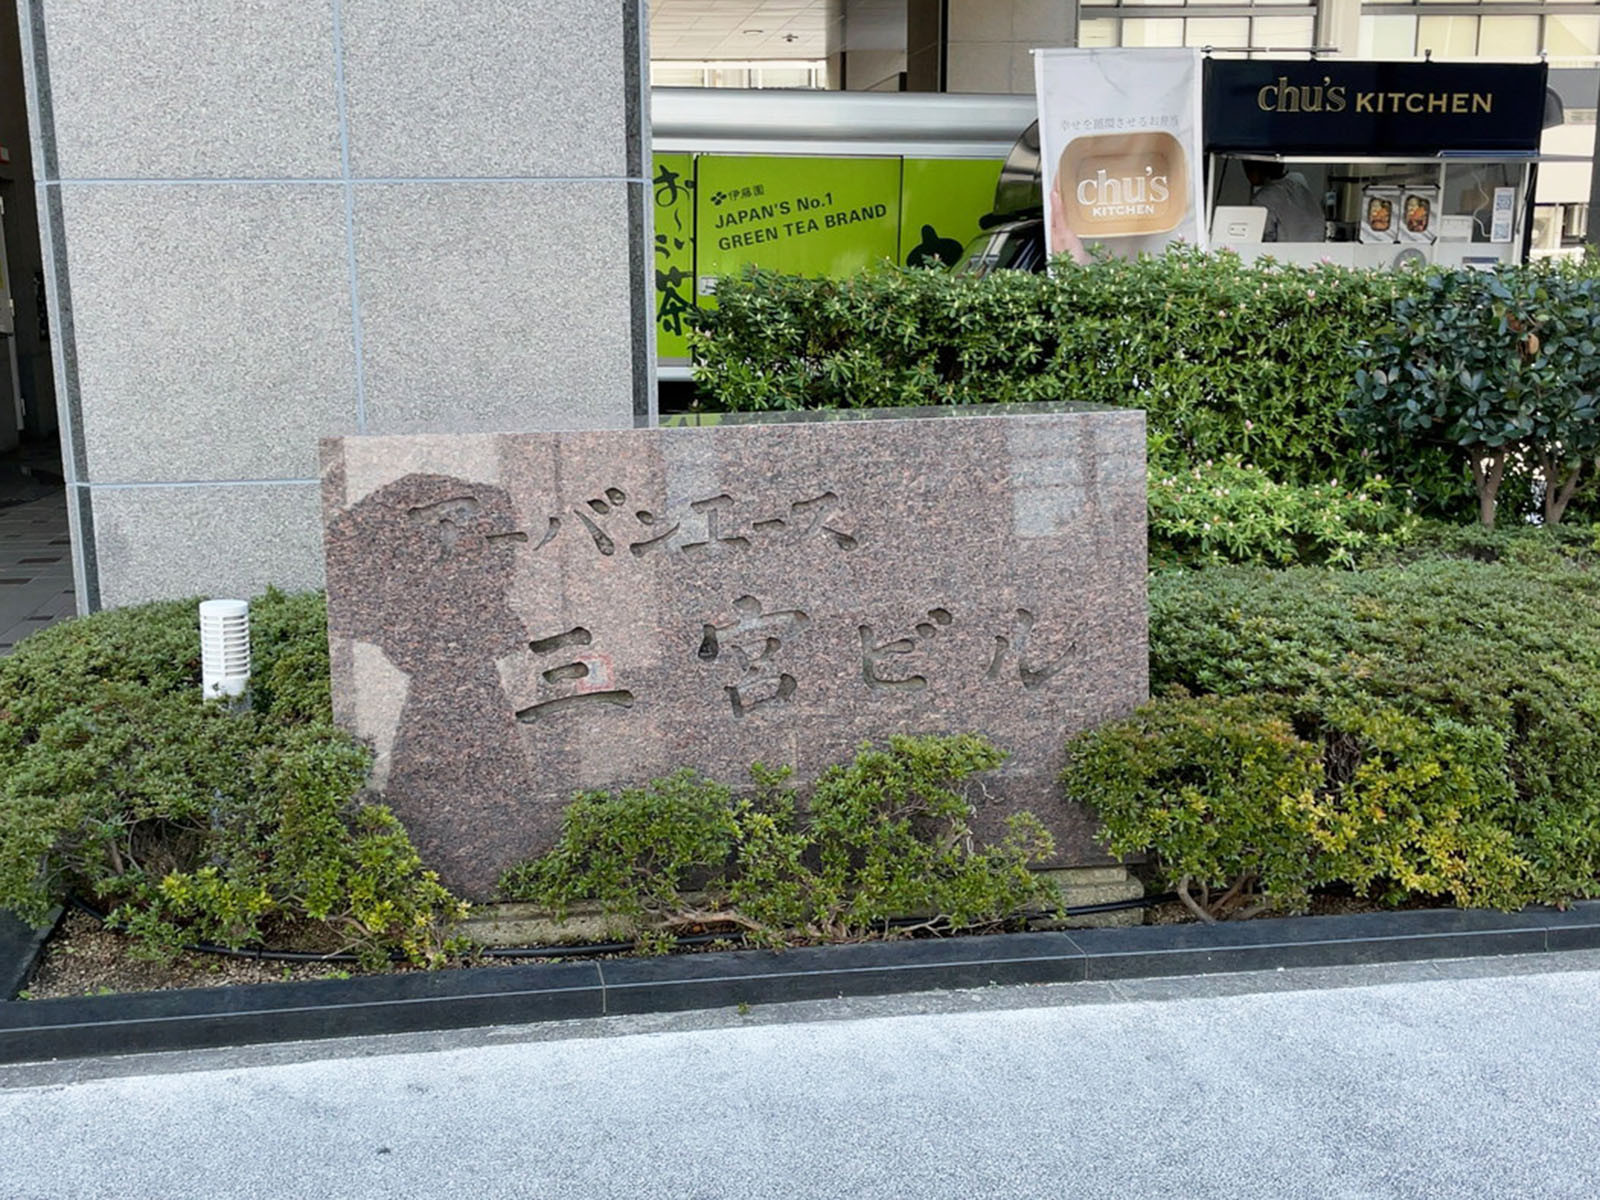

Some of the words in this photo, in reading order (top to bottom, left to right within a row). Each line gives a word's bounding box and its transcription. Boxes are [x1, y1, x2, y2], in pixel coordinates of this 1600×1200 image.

[1257, 76, 1346, 112] chu's
[1355, 92, 1493, 113] KITCHEN
[1076, 166, 1169, 206] chu's
[715, 201, 790, 229] JAPAN'S
[797, 192, 833, 212] No.1
[719, 227, 778, 250] GREEN
[784, 218, 819, 237] TEA
[825, 204, 887, 228] BRAND
[1092, 204, 1155, 217] KITCHEN
[406, 487, 859, 558] アーバンエース
[515, 595, 1077, 721] 三宮ビル
